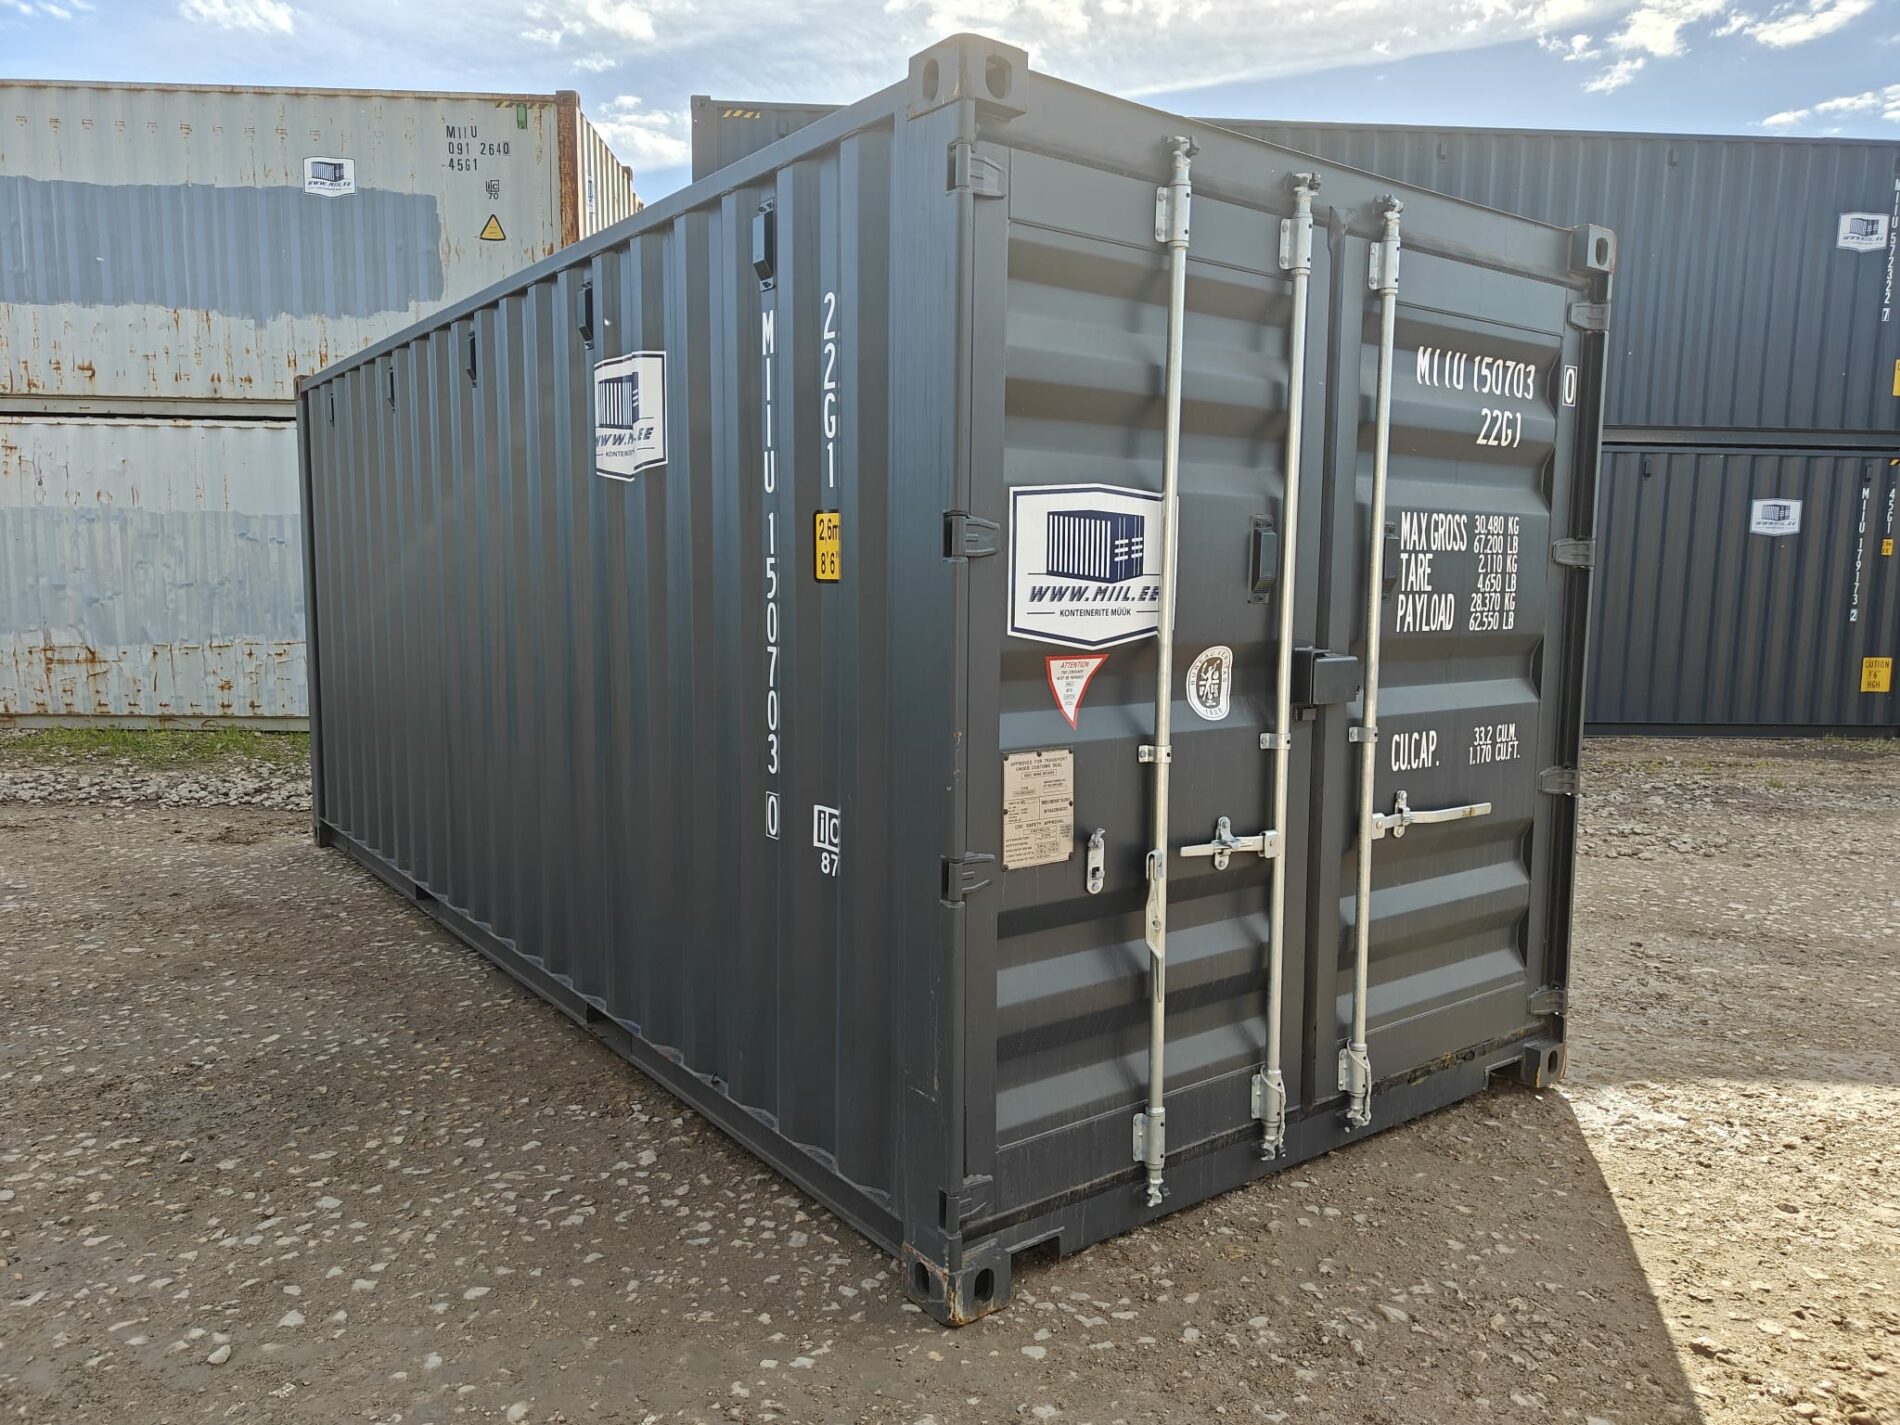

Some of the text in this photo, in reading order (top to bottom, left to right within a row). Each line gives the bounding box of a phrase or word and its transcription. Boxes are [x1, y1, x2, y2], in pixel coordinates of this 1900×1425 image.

[446, 125, 477, 139] MIIU
[448, 141, 469, 155] 091
[448, 157, 477, 172] 45G1
[488, 192, 499, 200] 70
[1884, 232, 1896, 304] 572322
[1882, 308, 1890, 321] 7
[1416, 346, 1577, 405] MIIU 150703 0
[823, 291, 836, 488] 22G1
[1476, 408, 1522, 448] 22G1
[1886, 488, 1896, 534] 45G1
[1401, 511, 1467, 552] MAX GROSS
[1474, 515, 1520, 535] 30.480 KG
[1473, 535, 1518, 554] 67.200 LB
[1849, 487, 1870, 621] MIIU 179173 2
[762, 310, 779, 838] MIIU 150703 0
[1400, 553, 1433, 592] TARE
[1478, 555, 1518, 573] 2.110 KG
[1477, 574, 1516, 592] 4.650 LB
[1029, 585, 1159, 602] WWW.MIIL.EE
[1470, 593, 1516, 611] 28.370 KG
[1060, 607, 1131, 617] KONTEINERITE MÜÜK
[1396, 593, 1455, 633] PAYLOAD
[1502, 612, 1514, 630] LB
[1473, 726, 1493, 746] 33.2
[1391, 730, 1440, 771] CU.CAP.
[1469, 744, 1492, 765] 1.170
[821, 852, 839, 876] 87
